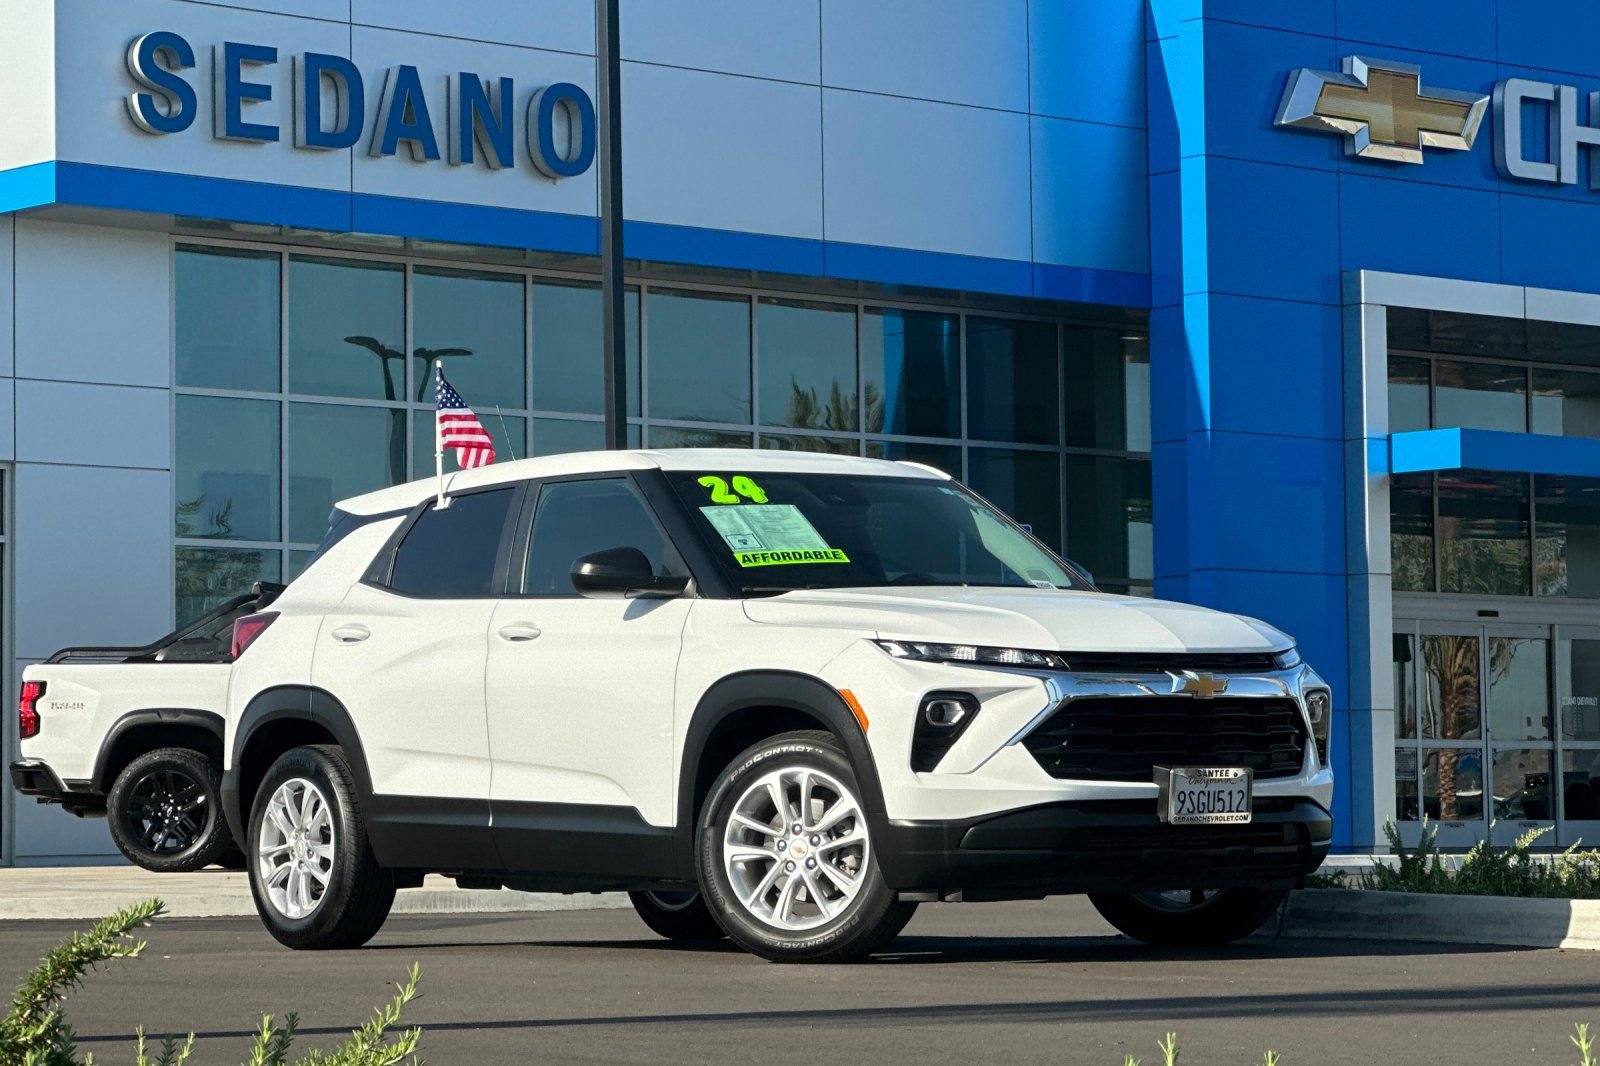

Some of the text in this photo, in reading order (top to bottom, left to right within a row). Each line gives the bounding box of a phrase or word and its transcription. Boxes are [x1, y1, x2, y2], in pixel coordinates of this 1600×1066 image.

[127, 31, 596, 179] SEDANO
[1494, 78, 1600, 188] CH
[697, 475, 769, 504] 24
[742, 550, 842, 565] AFFORDABLE
[1197, 769, 1230, 778] SANTEE
[1177, 790, 1245, 813] 9SGU512
[1174, 814, 1249, 823] SEDANOCHEVROLET.COM
